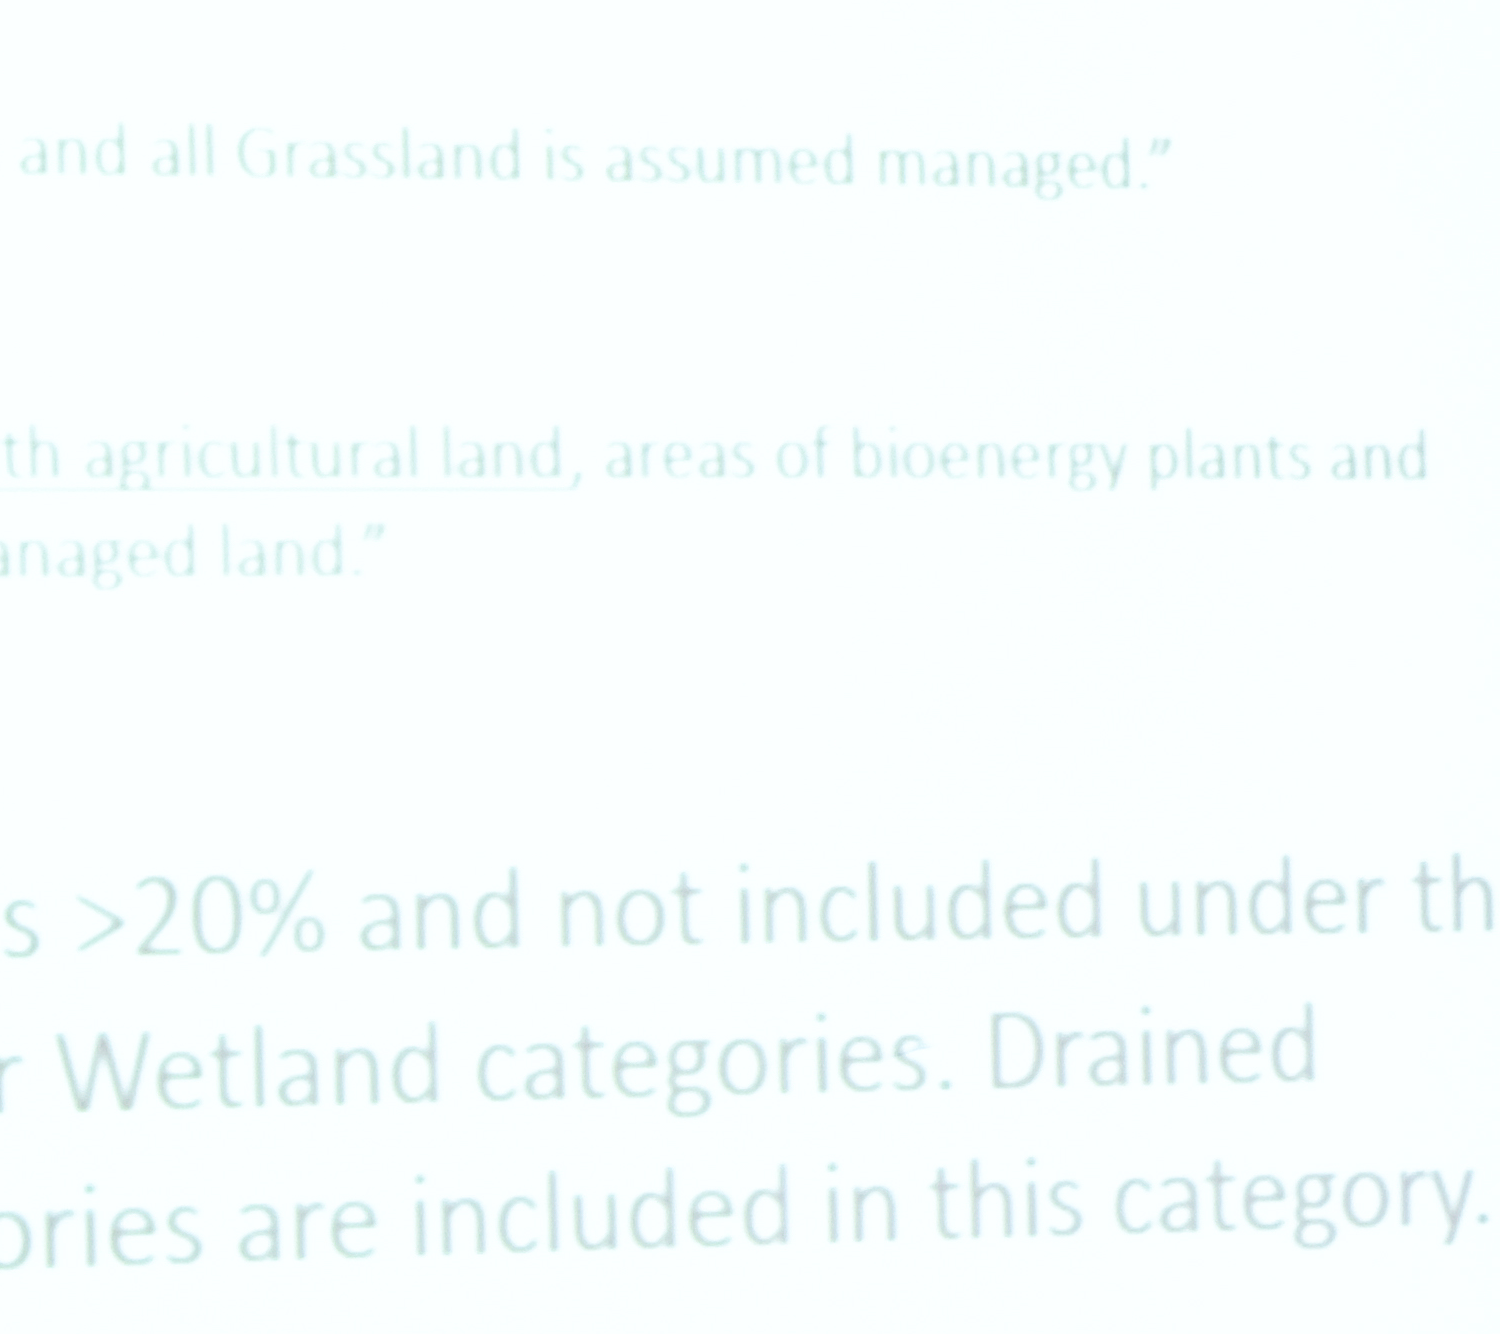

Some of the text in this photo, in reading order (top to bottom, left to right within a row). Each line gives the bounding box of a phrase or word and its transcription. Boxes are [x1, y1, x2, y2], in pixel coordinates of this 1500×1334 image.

[17, 122, 129, 178] and
[150, 122, 217, 179] all
[234, 125, 523, 182] Grassland
[543, 123, 587, 183] is
[603, 132, 857, 187] assumed
[83, 424, 420, 494] agricultural
[441, 424, 584, 491] land,
[603, 440, 758, 481] areas
[773, 424, 830, 480] of
[850, 425, 1130, 493] bioenergy
[1146, 426, 1314, 492] plants
[1328, 427, 1430, 483] and
[77, 869, 327, 957] >20%
[358, 866, 521, 952] and
[559, 872, 703, 948] not
[738, 857, 1103, 945] included
[1138, 854, 1385, 938] under
[55, 1021, 440, 1114] Wetland
[476, 1011, 953, 1119] categories.
[989, 1001, 1317, 1090] Drained
[237, 1200, 378, 1263] are
[414, 1163, 790, 1257] included
[826, 1162, 898, 1244] in
[929, 1156, 1084, 1241] this
[1114, 1159, 1490, 1251] category.
